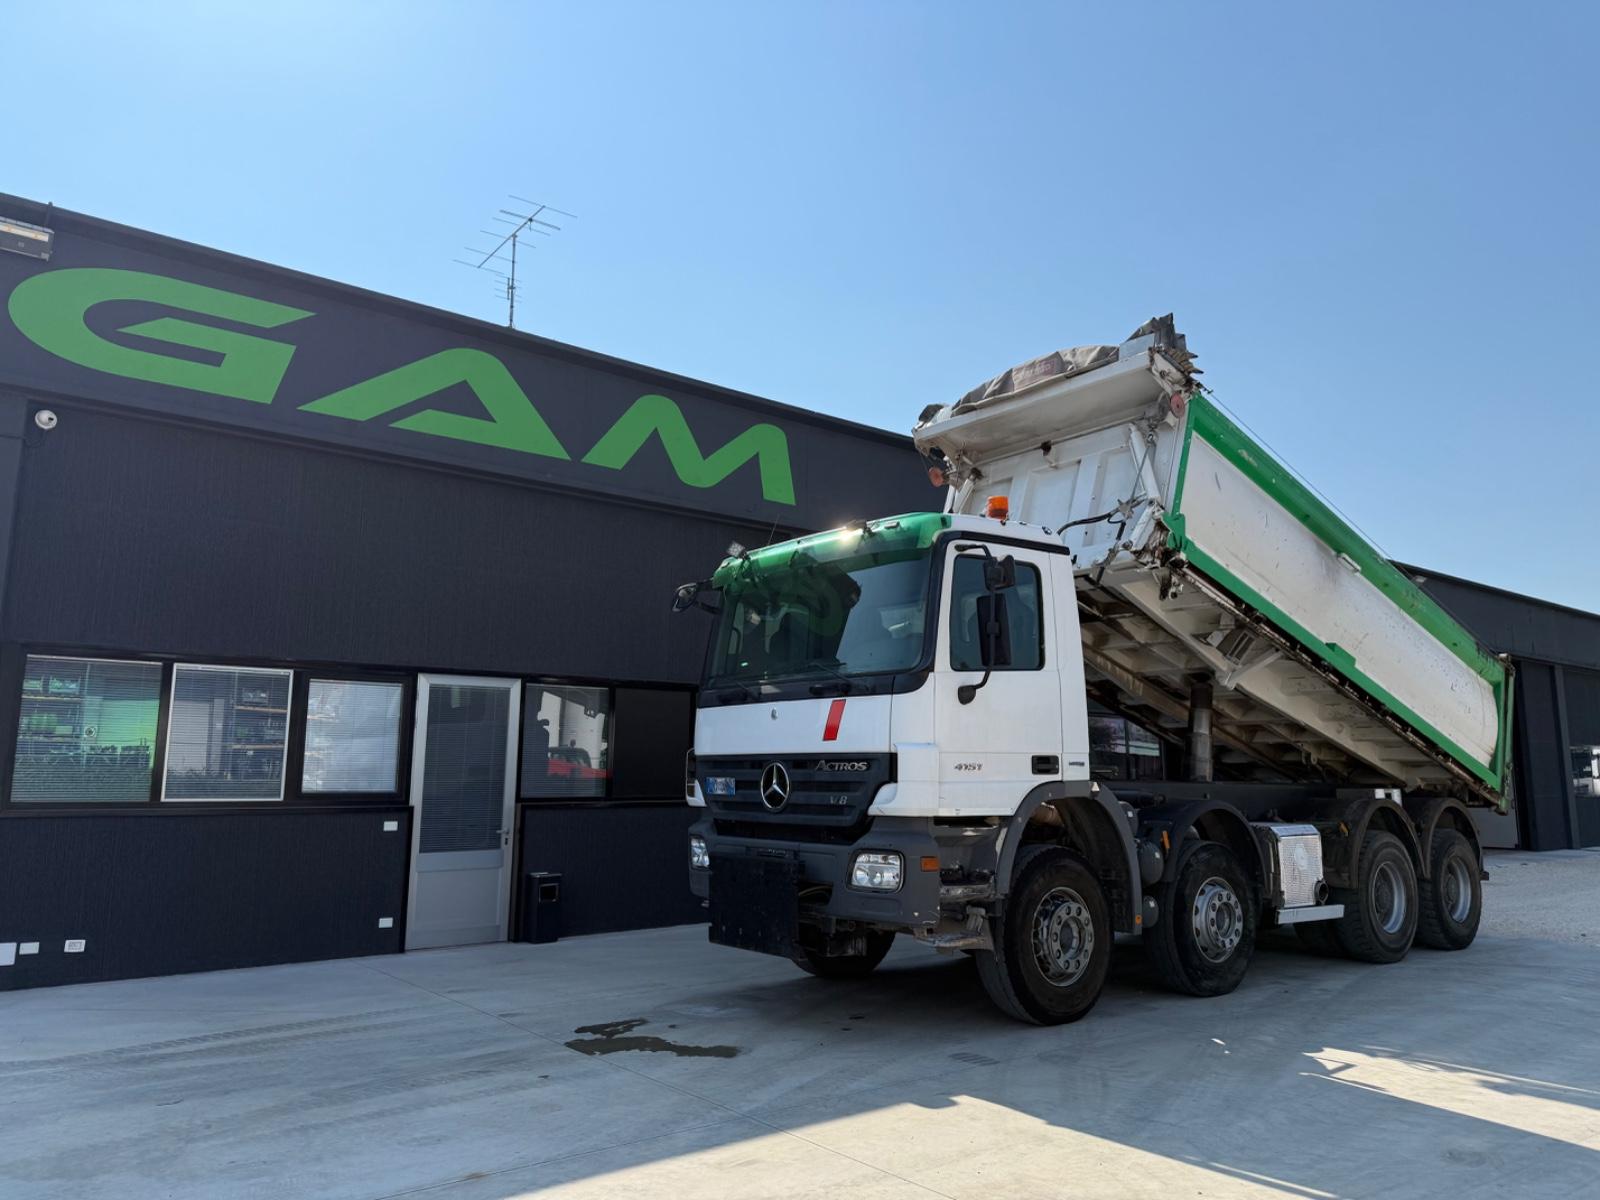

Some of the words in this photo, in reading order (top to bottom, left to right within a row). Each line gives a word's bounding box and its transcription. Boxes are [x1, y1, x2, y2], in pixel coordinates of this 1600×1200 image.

[8, 267, 796, 505] GAM
[815, 759, 868, 771] ACTROS
[830, 795, 848, 805] V8
